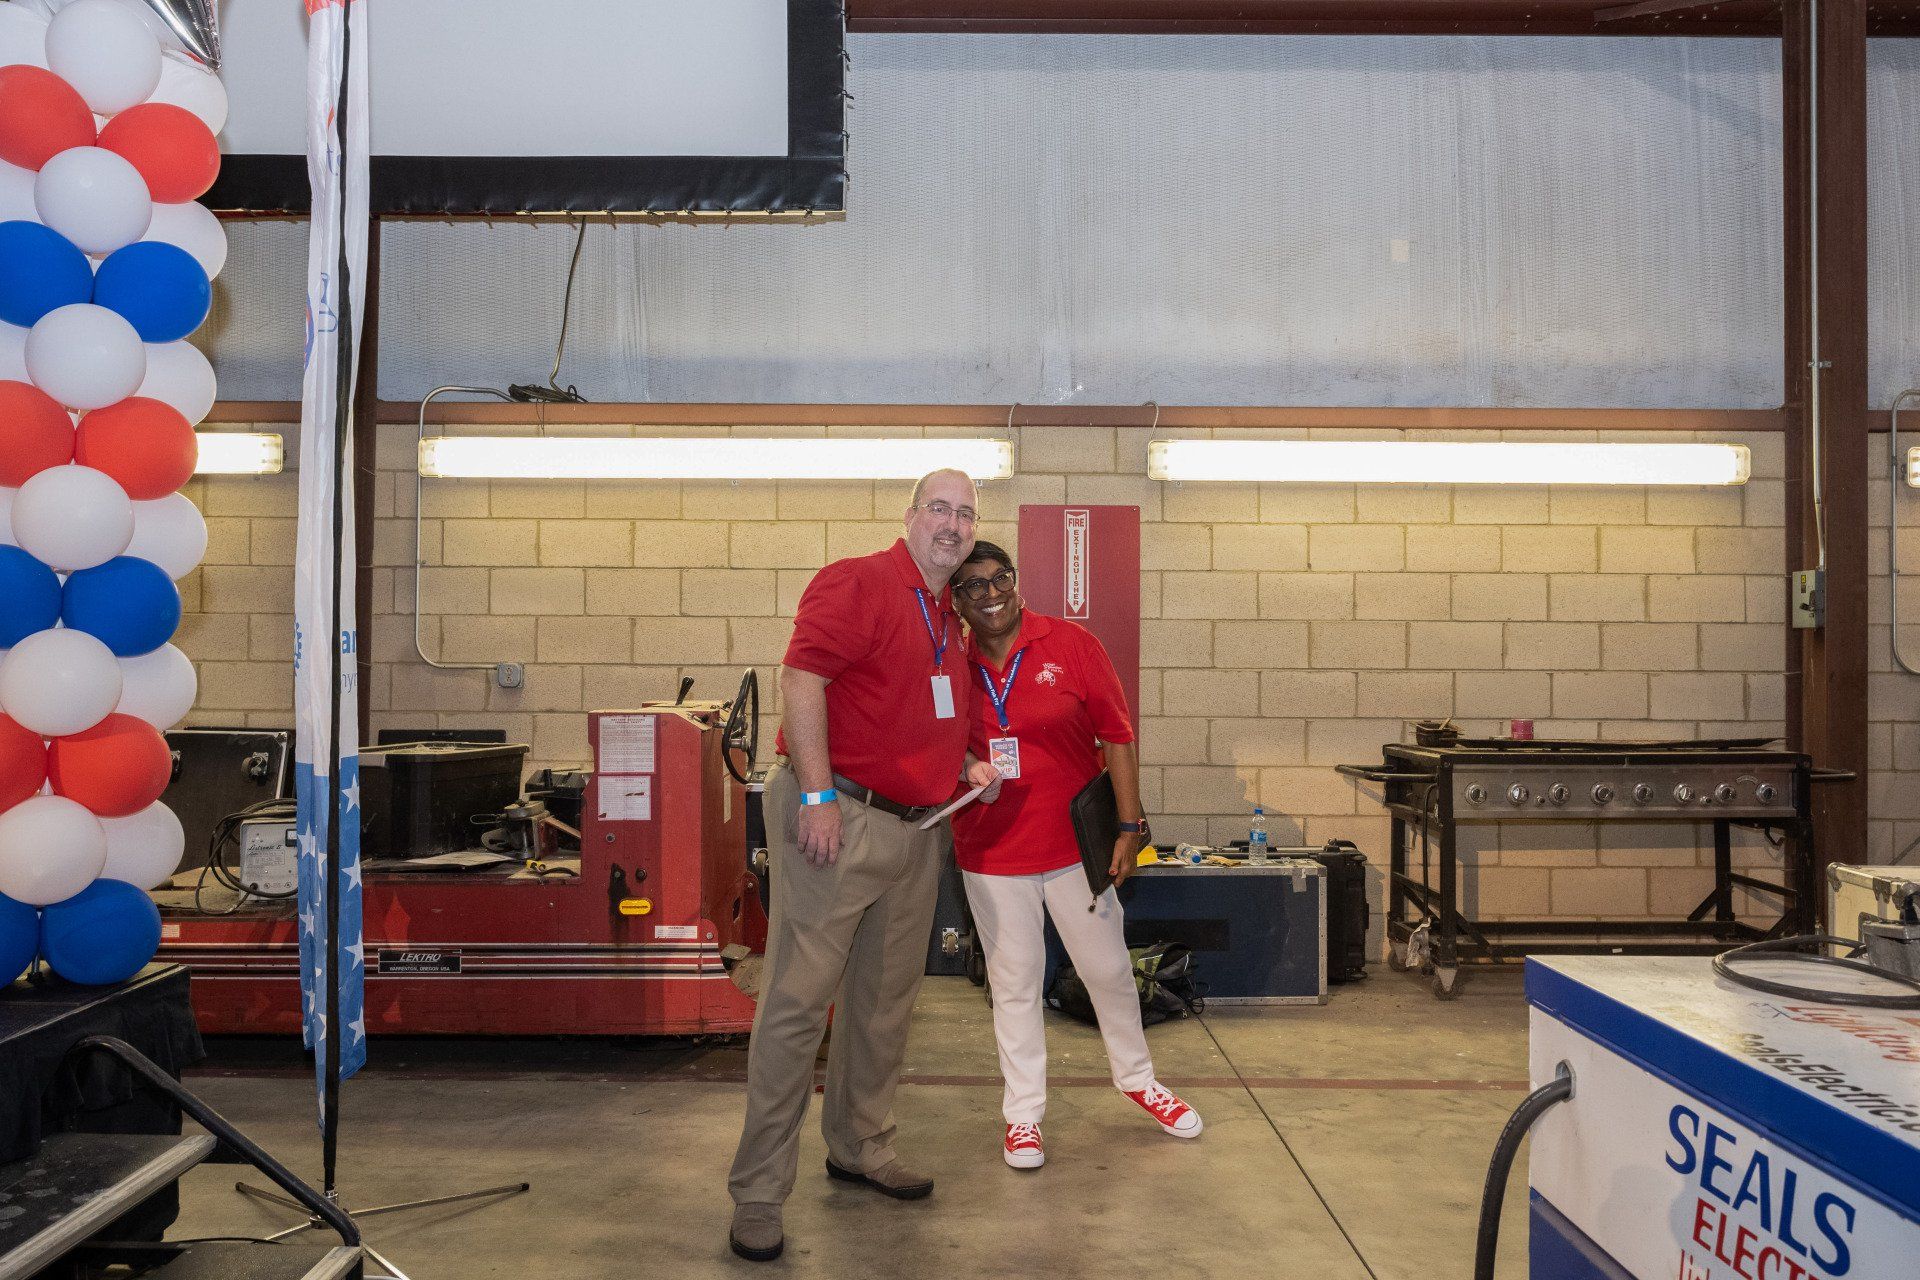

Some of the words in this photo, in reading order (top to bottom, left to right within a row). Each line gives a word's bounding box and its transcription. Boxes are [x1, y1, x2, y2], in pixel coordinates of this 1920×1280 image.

[1068, 518, 1084, 527] FIRE
[400, 953, 441, 962] LEKTRO
[1665, 1104, 1857, 1277] SEALS
